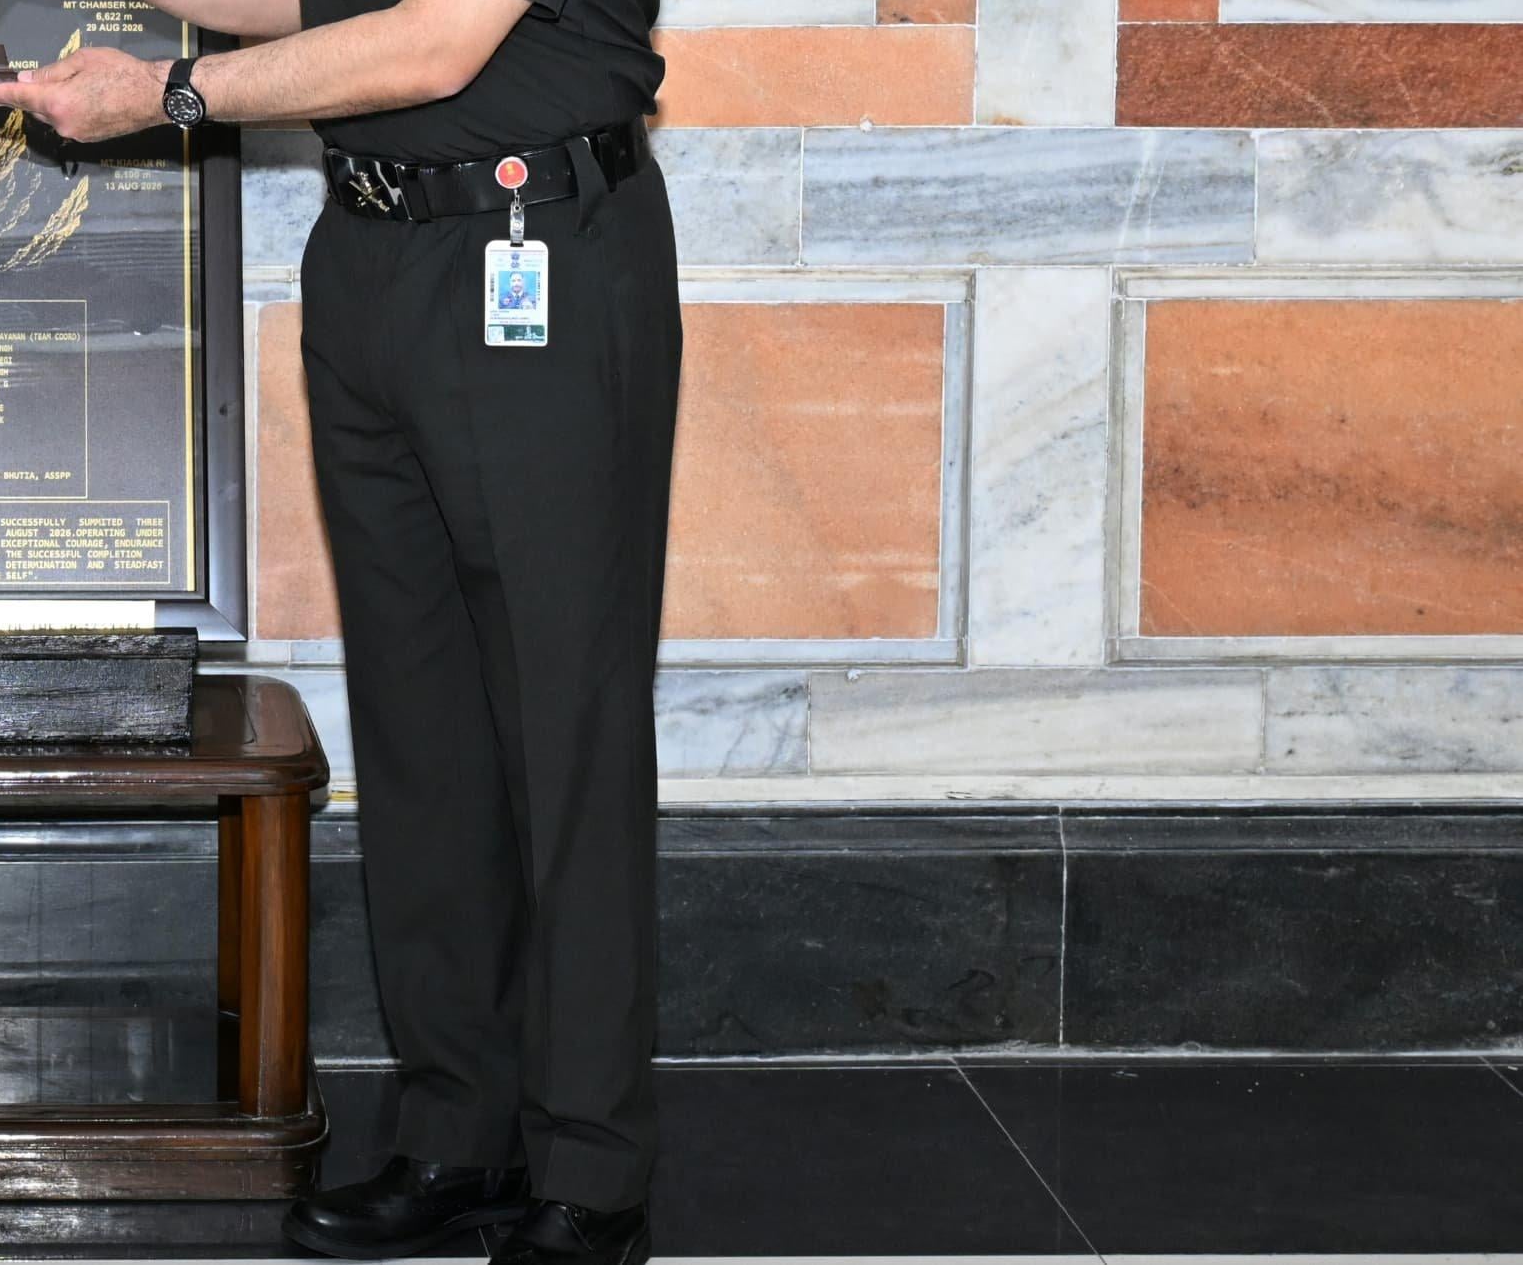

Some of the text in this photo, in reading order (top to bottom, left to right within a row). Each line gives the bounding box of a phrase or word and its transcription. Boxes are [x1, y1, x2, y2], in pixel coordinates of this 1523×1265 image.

[63, 1, 77, 9] MT
[79, 1, 126, 9] CHAMSER
[96, 12, 121, 22] 6,622
[86, 23, 143, 32] 29 AUG 2026
[9, 60, 38, 69] ANGRI
[118, 182, 139, 191] AUG
[45, 471, 70, 479] ASSPP
[0, 518, 66, 527] SUCCESSFULLY
[79, 518, 122, 527] SUMMITED
[137, 518, 162, 527] THREE
[6, 528, 38, 537] AUGUST
[136, 528, 163, 537] UNDER
[1, 539, 60, 548] EXCEPTIONAL
[66, 539, 108, 549] COURAGE,
[115, 539, 163, 548] ENDURANCE
[6, 550, 22, 559] THE
[28, 550, 81, 559] SUCCESSFUL
[88, 550, 142, 559] COMPLETION
[6, 561, 76, 570] DETERMINATION
[87, 561, 104, 570] AND
[114, 561, 162, 570] STEADFAST
